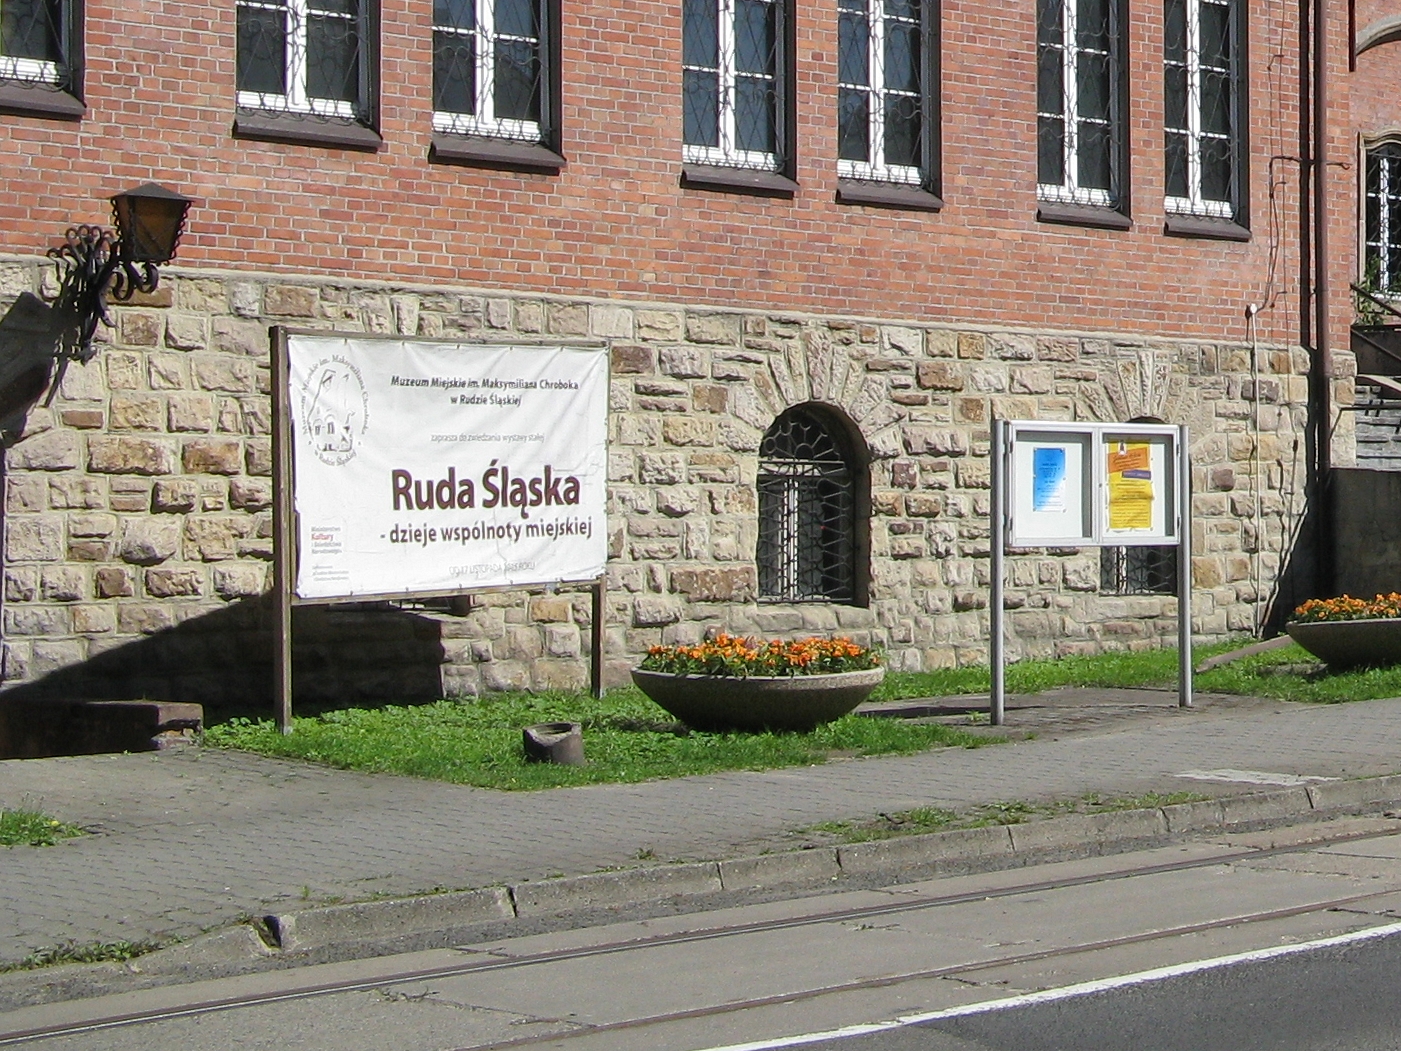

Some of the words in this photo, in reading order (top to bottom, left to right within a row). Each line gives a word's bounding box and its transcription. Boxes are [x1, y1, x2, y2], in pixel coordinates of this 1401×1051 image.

[391, 375, 429, 387] Muzeum
[429, 377, 466, 390] Miejskie
[481, 378, 538, 391] Maksymiliana
[539, 379, 579, 390] Chroboka
[450, 396, 458, 404] w
[459, 394, 487, 405] Rudzie
[489, 392, 522, 407] Śląskiej
[391, 466, 475, 510] Ruda
[482, 458, 580, 519] Śląska
[389, 523, 437, 548] dzieje
[440, 520, 522, 545] wspólnoty
[525, 516, 593, 543] miejskiej
